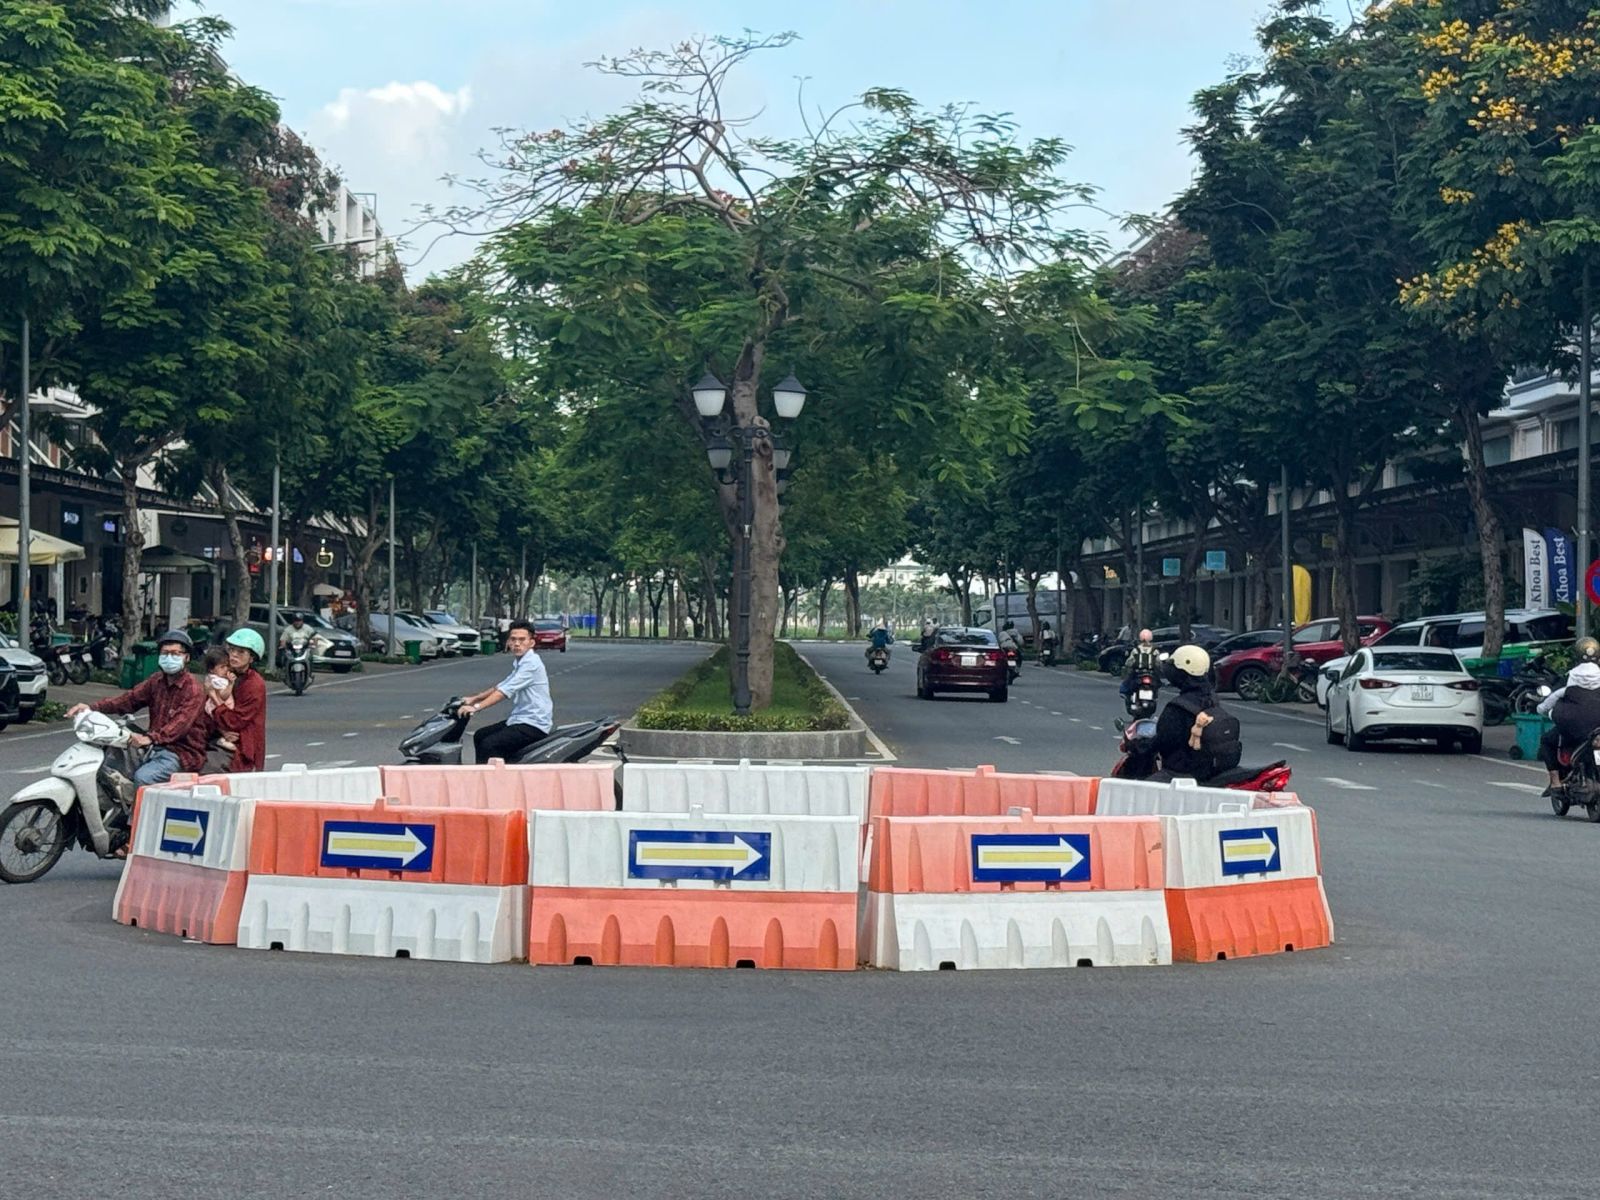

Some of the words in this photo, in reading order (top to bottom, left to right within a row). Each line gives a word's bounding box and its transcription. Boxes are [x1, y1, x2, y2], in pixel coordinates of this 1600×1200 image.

[1530, 540, 1541, 566] Best
[1553, 536, 1567, 565] Best
[1531, 569, 1541, 603] Khoa
[1556, 567, 1569, 603] Khoa
